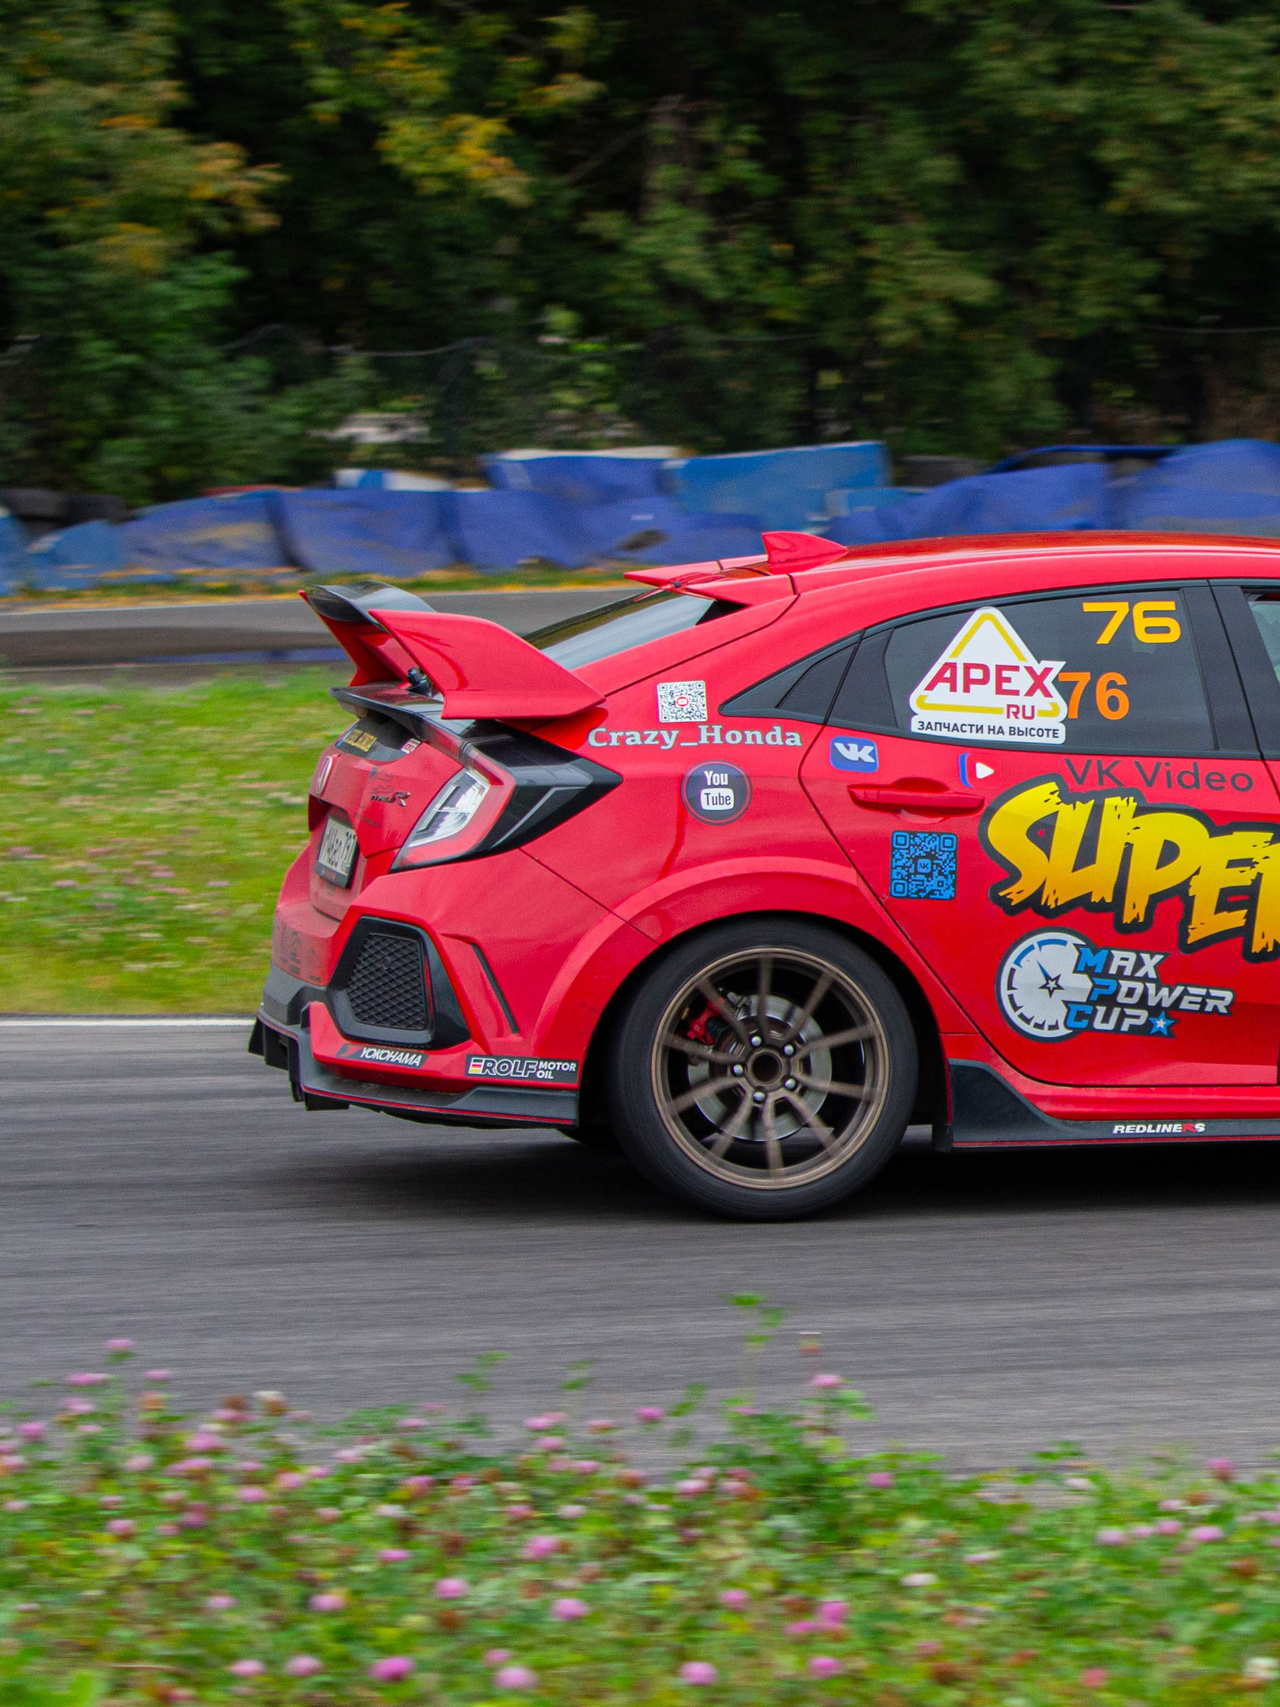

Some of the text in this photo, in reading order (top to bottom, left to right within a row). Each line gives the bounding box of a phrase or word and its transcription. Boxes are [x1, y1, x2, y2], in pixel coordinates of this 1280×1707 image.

[1082, 601, 1181, 645] 76
[924, 661, 1054, 698] APEX
[1058, 672, 1130, 720] 76
[1006, 704, 1036, 720] RU
[587, 723, 803, 750] Crazy_Honda
[917, 720, 1060, 738] ЗАПЧАСТИ НА ВЫСОТЕ
[704, 770, 729, 786] You
[1065, 758, 1255, 793] VK Video
[704, 792, 732, 806] Tube
[1076, 947, 1165, 979] MAX
[1090, 977, 1235, 1014] POWER
[1064, 1003, 1150, 1032] CUP
[359, 1047, 423, 1067] YOKOHAMA
[481, 1058, 577, 1078] ROLF MOTOR
[536, 1070, 554, 1080] OIL
